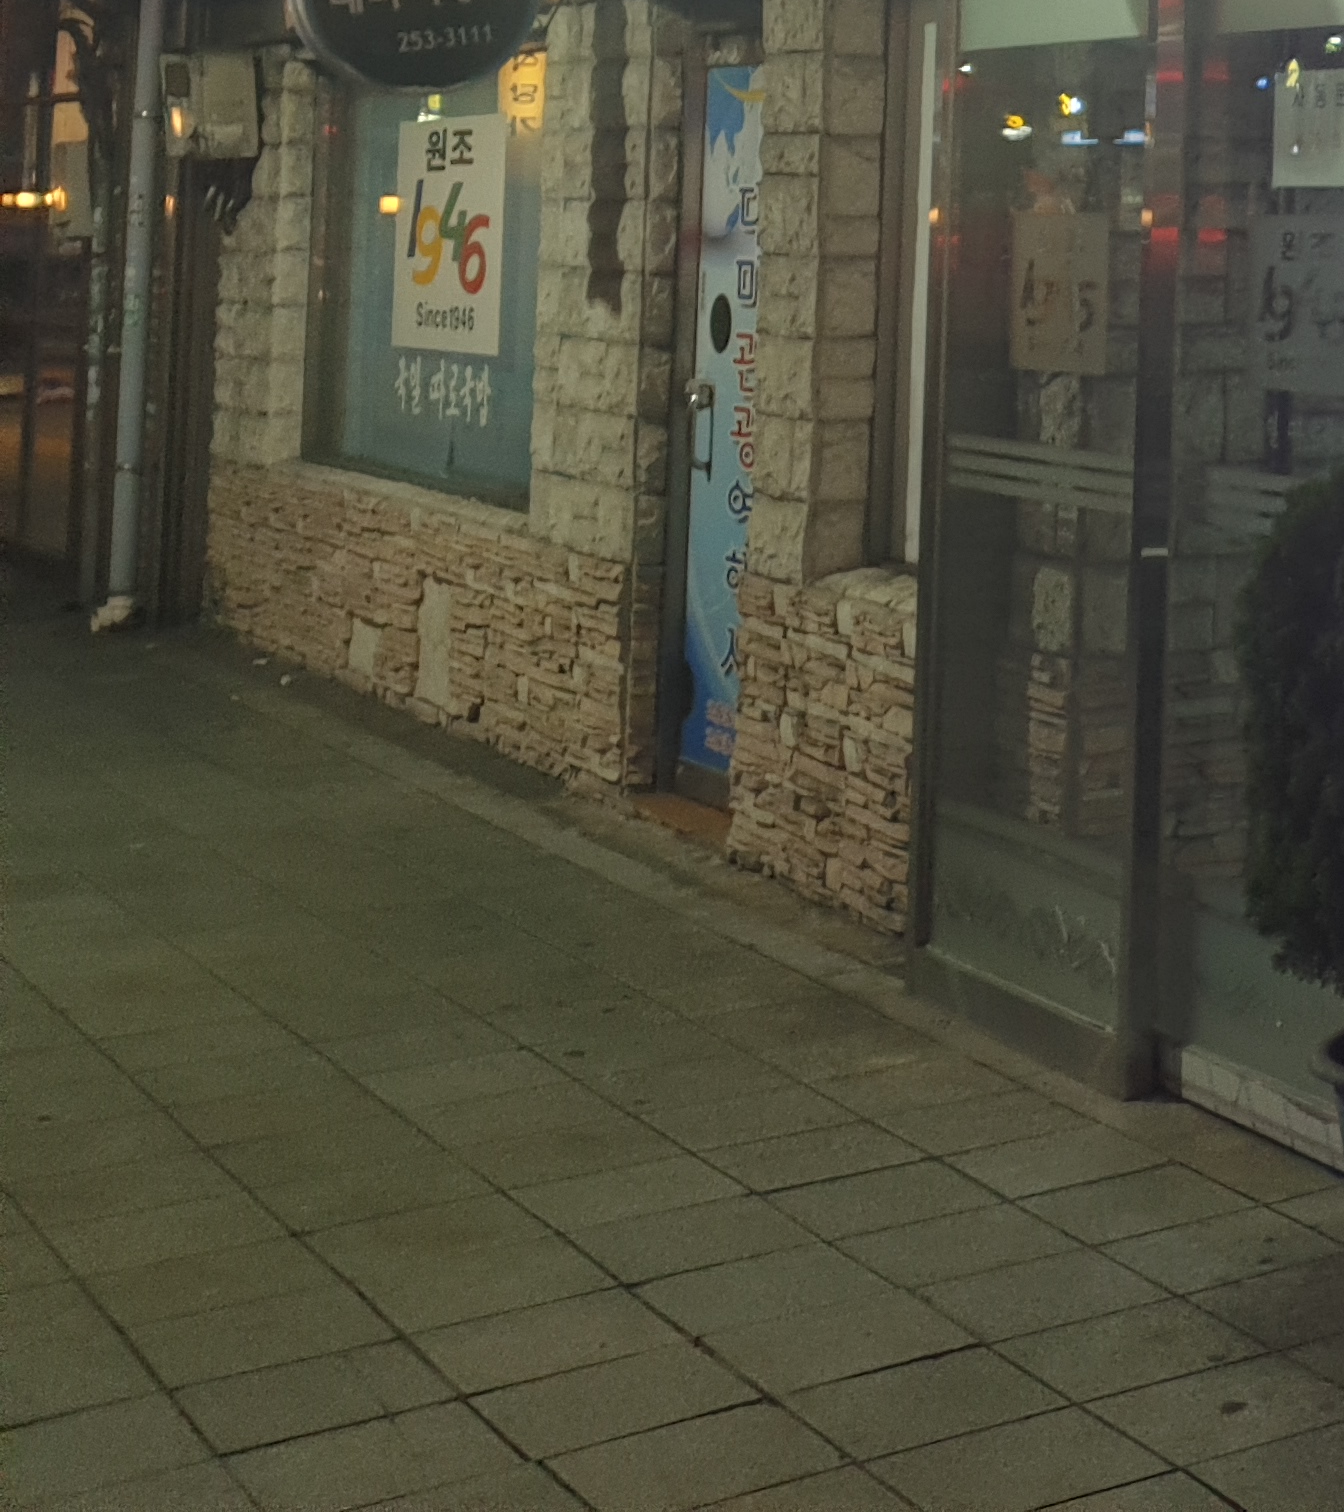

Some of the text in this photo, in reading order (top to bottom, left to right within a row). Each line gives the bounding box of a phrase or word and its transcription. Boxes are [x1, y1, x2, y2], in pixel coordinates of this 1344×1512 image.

[397, 24, 493, 52] 253-3111
[424, 128, 474, 172] 원조
[407, 178, 490, 295] 1946
